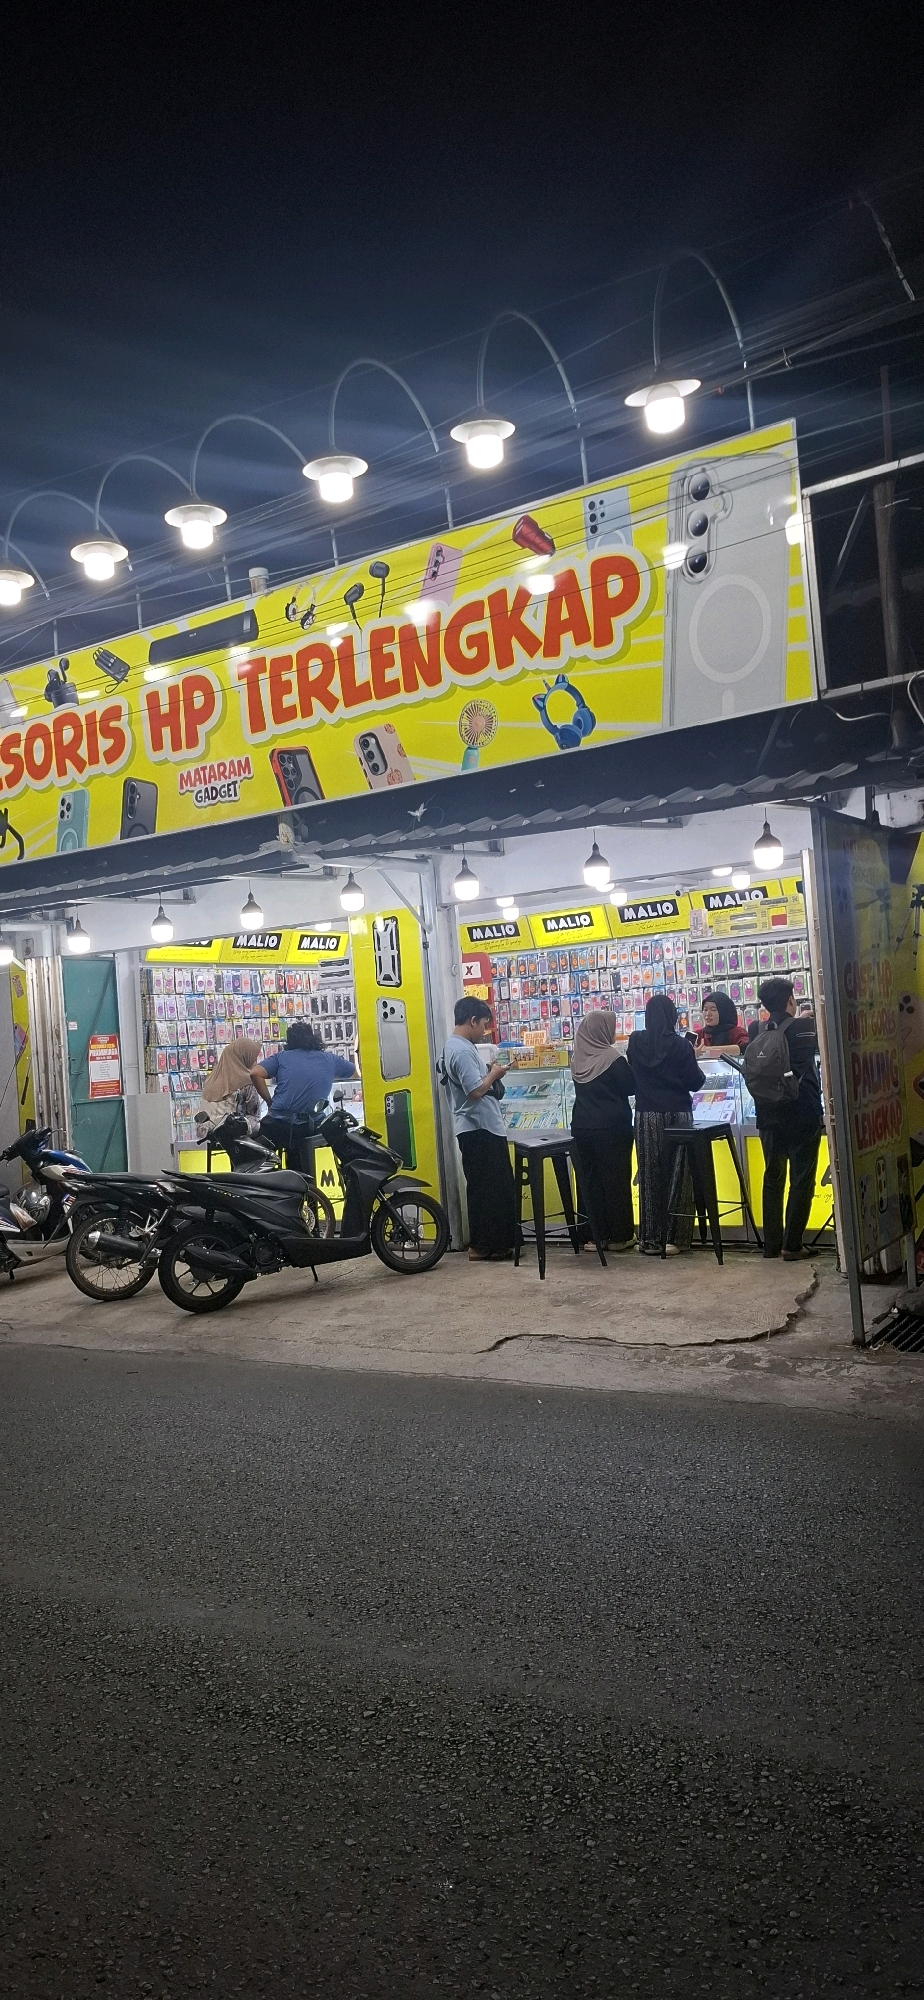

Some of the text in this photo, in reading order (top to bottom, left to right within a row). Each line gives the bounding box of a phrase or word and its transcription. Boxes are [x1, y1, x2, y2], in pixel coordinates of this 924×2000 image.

[0, 554, 642, 791] SORIS HP TERLENGKAP
[179, 756, 252, 790] MATARAM
[195, 780, 238, 803] GADGET
[624, 901, 674, 920] MALIO
[708, 889, 764, 909] MALIO
[472, 924, 516, 939] MALIO
[546, 914, 591, 930] MALIO
[236, 933, 279, 948] MALIO
[300, 937, 338, 949] MALIO
[877, 957, 891, 1000] HP
[848, 1011, 868, 1041] ANTI
[852, 1049, 899, 1102] PALING
[854, 1101, 903, 1151] LENGKAP
